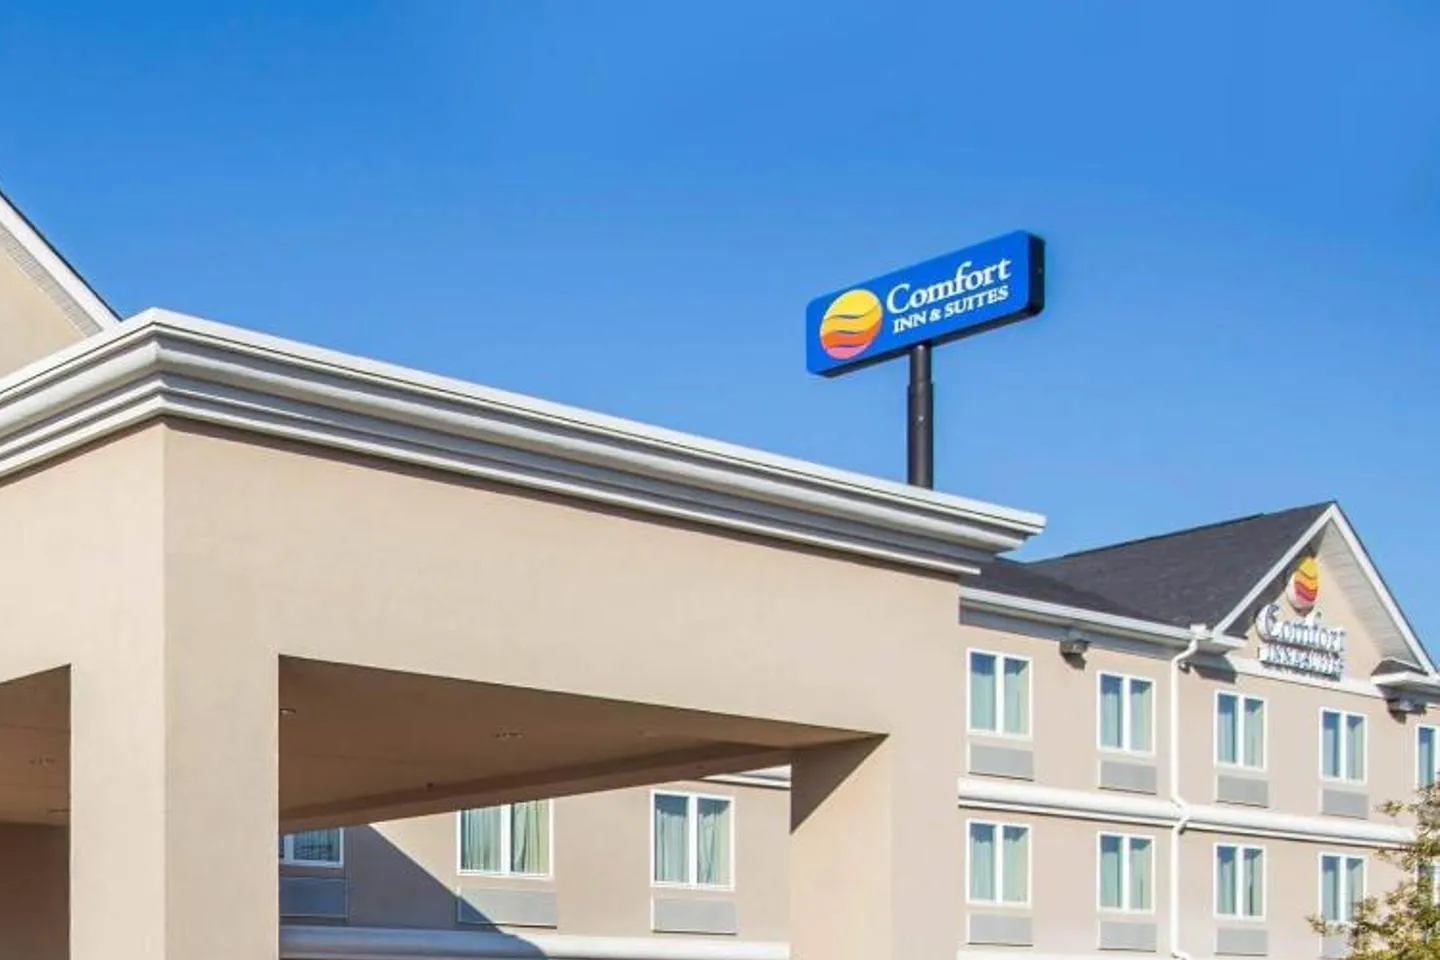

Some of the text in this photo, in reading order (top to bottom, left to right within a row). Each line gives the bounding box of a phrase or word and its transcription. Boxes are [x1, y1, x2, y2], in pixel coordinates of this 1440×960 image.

[886, 258, 1012, 314] Comfort
[892, 284, 1010, 334] INN & SUITES
